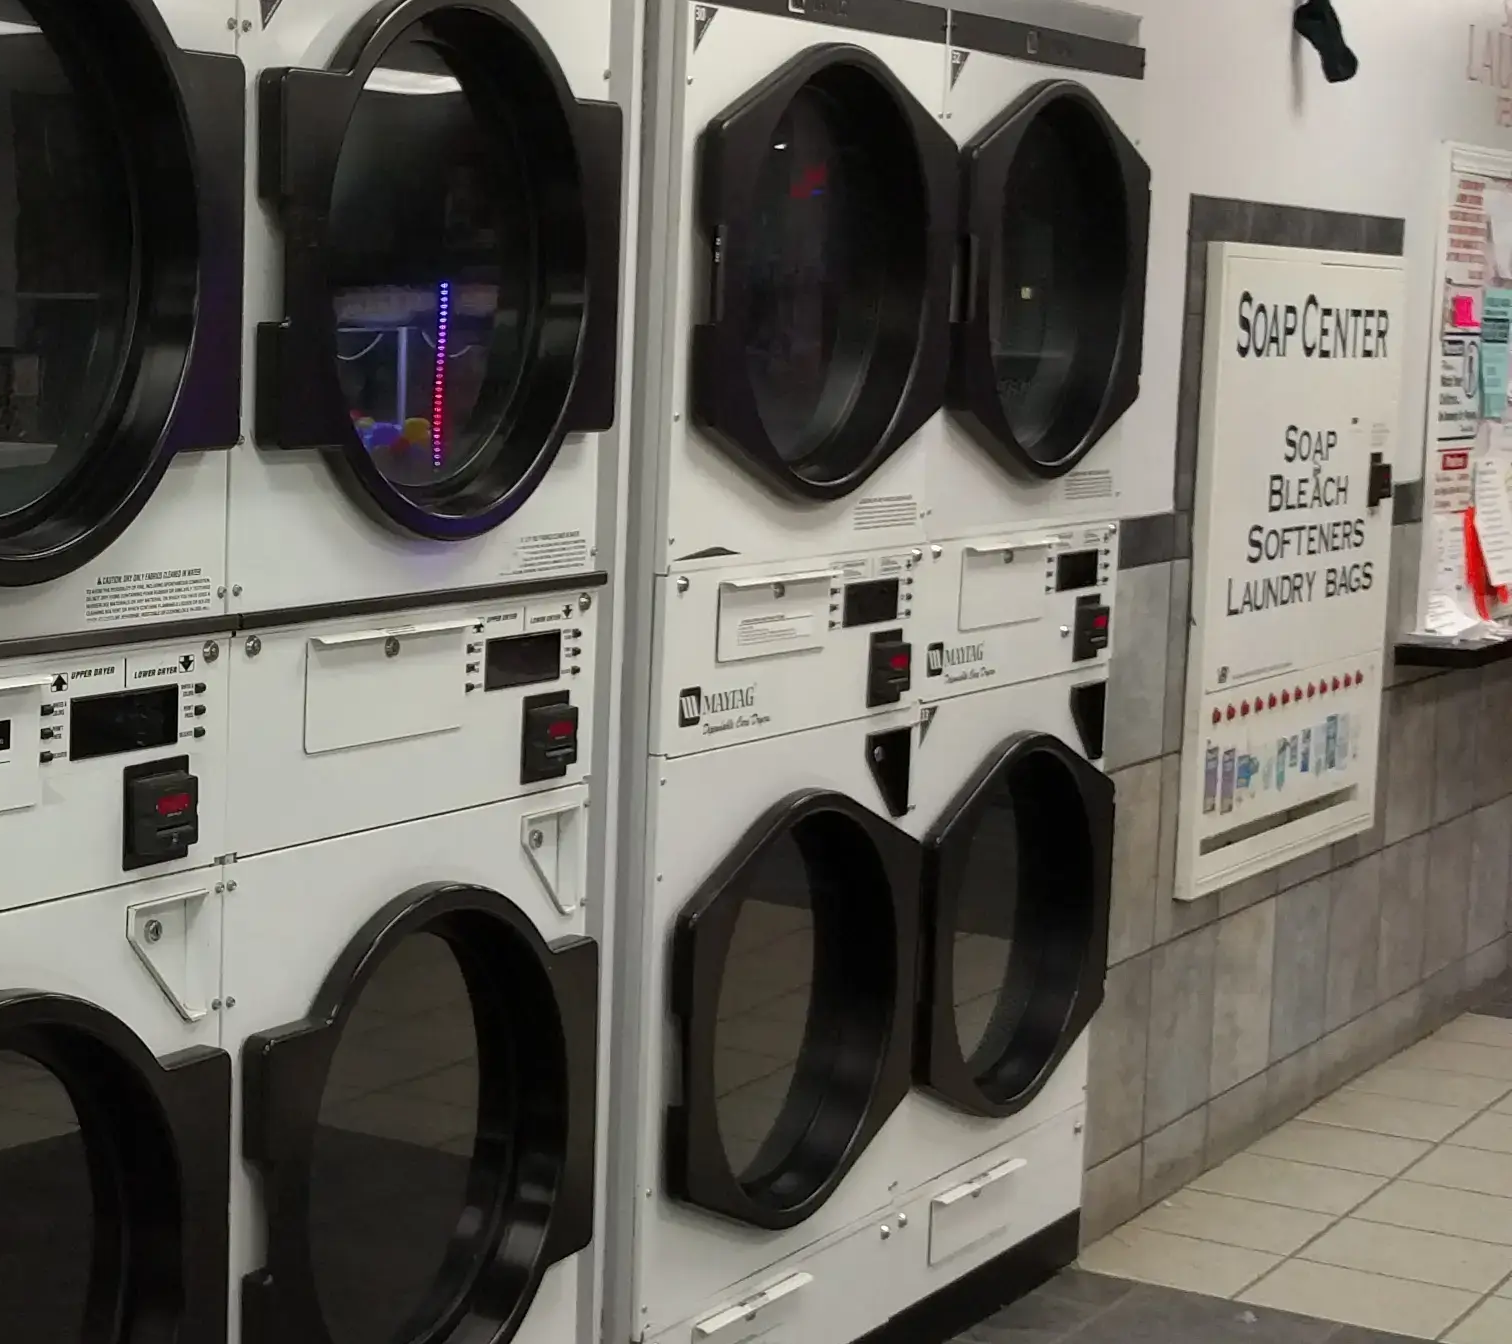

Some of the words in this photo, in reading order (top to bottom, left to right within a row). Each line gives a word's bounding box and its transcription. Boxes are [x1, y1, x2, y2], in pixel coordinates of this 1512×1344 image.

[1236, 290, 1298, 358] SOAP
[1302, 294, 1389, 358] CENTER
[1284, 424, 1337, 463] SOAP
[1268, 474, 1349, 513] BLEACH
[1246, 518, 1365, 564] SOFTENERS
[1226, 570, 1317, 616] LAUNDRY
[1324, 561, 1374, 598] BAGS
[71, 669, 93, 679] UPPER
[94, 666, 116, 676] DRYER
[134, 669, 157, 679] LOWER
[157, 666, 178, 676] DRYER
[944, 643, 983, 668] MAYTAG
[702, 686, 755, 715] MAYTAG
